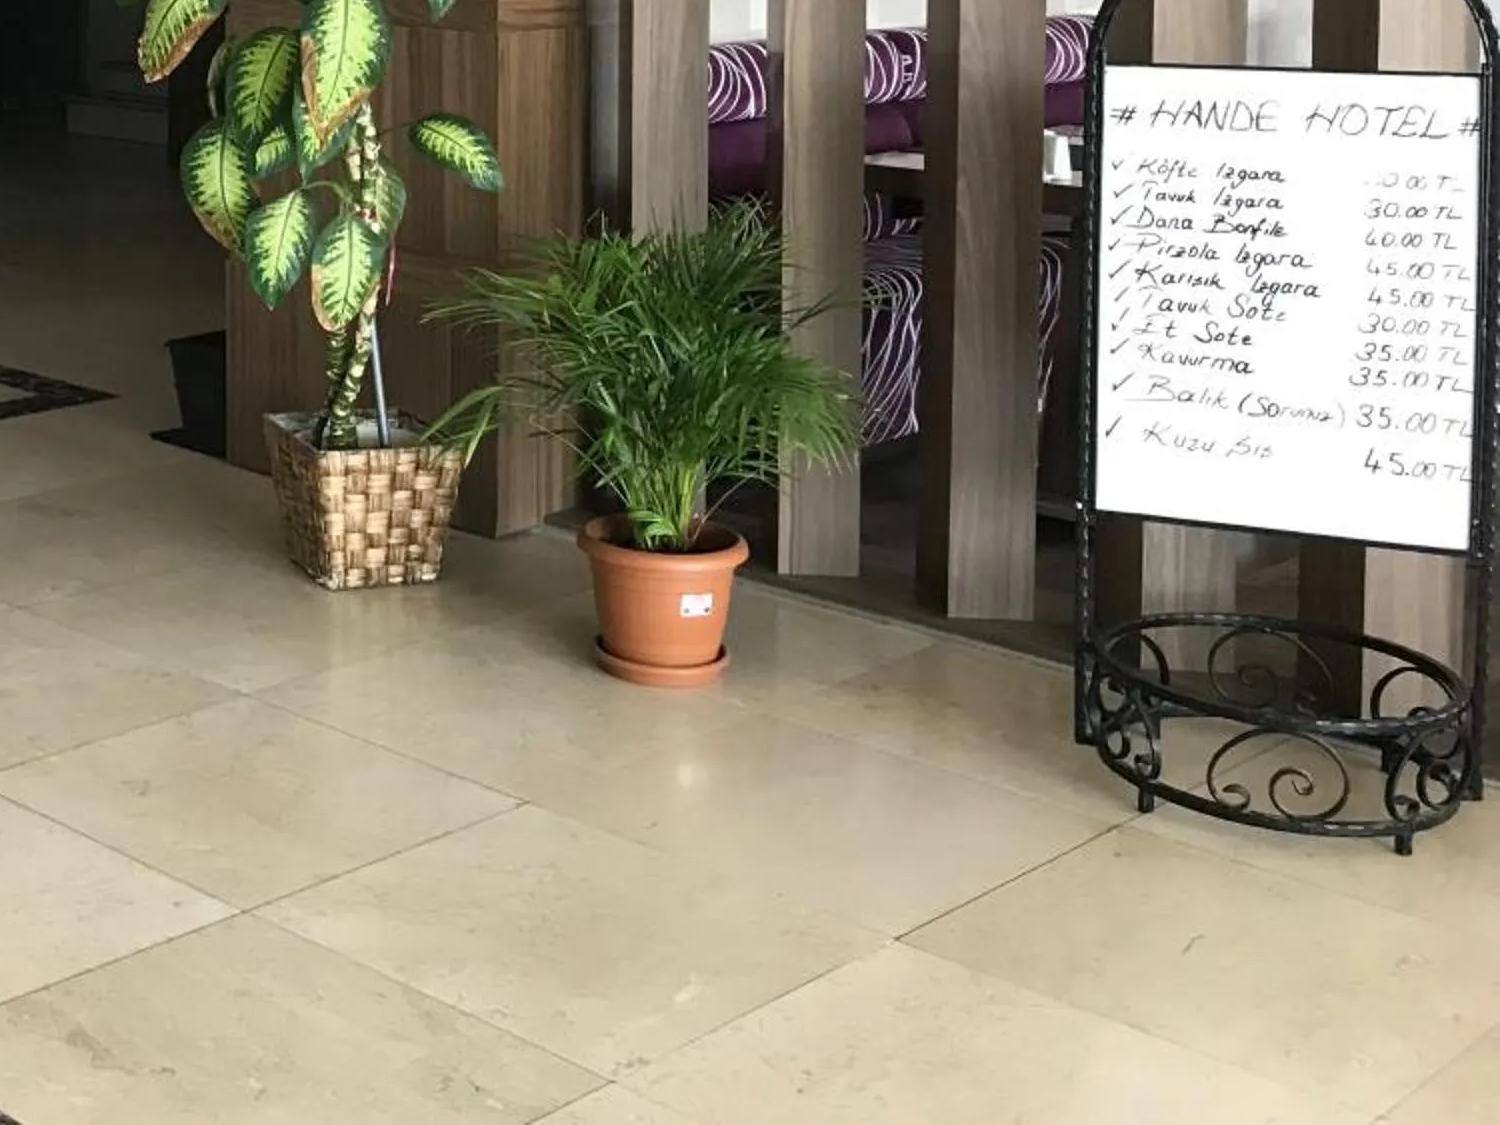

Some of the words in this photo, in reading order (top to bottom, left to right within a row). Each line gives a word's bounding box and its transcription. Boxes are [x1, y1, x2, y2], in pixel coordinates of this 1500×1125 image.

[1150, 99, 1281, 132] HANDE
[1305, 103, 1449, 139] HOTEL
[1363, 198, 1429, 220] 30.00
[1434, 205, 1463, 220] TL
[1364, 227, 1423, 248] 40.00
[1432, 232, 1458, 250] TL
[1366, 258, 1435, 280] 45.00
[1441, 264, 1471, 281] TL
[1367, 286, 1434, 308] 45.00
[1443, 294, 1477, 312] TL
[1357, 312, 1431, 335] 30.00
[1441, 320, 1469, 337] TL
[1354, 342, 1428, 363] 35.00
[1438, 346, 1469, 366] TL
[1348, 366, 1429, 388] 35.00
[1436, 374, 1474, 394] TL
[1356, 403, 1437, 435] 35.00
[1443, 418, 1474, 437] TL
[1364, 446, 1438, 479] 45.00
[1443, 463, 1474, 482] TL
